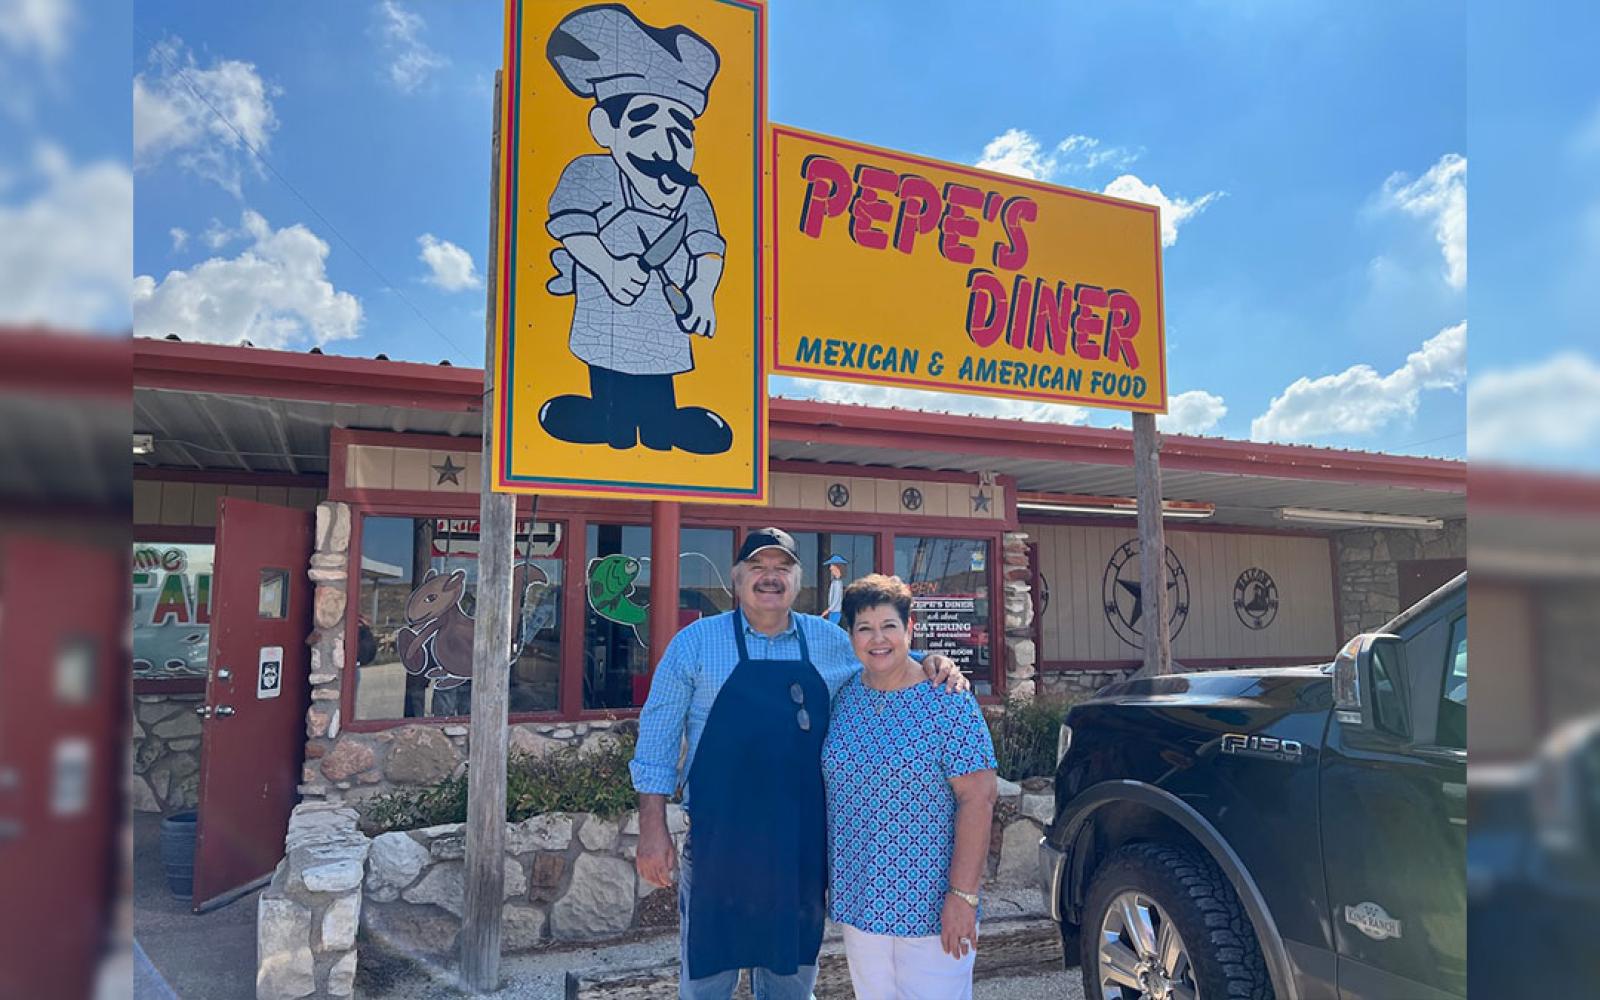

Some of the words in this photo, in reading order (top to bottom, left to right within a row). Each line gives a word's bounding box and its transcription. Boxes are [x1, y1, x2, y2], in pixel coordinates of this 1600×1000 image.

[800, 154, 1038, 271] PEPE'S
[966, 268, 1142, 370] DINER
[795, 336, 919, 375] MEXICAN
[928, 351, 944, 377] &
[958, 356, 1085, 396] AMERICAN
[1090, 371, 1148, 399] FOOD
[1107, 541, 1185, 577] TES
[913, 623, 971, 631] CATERING
